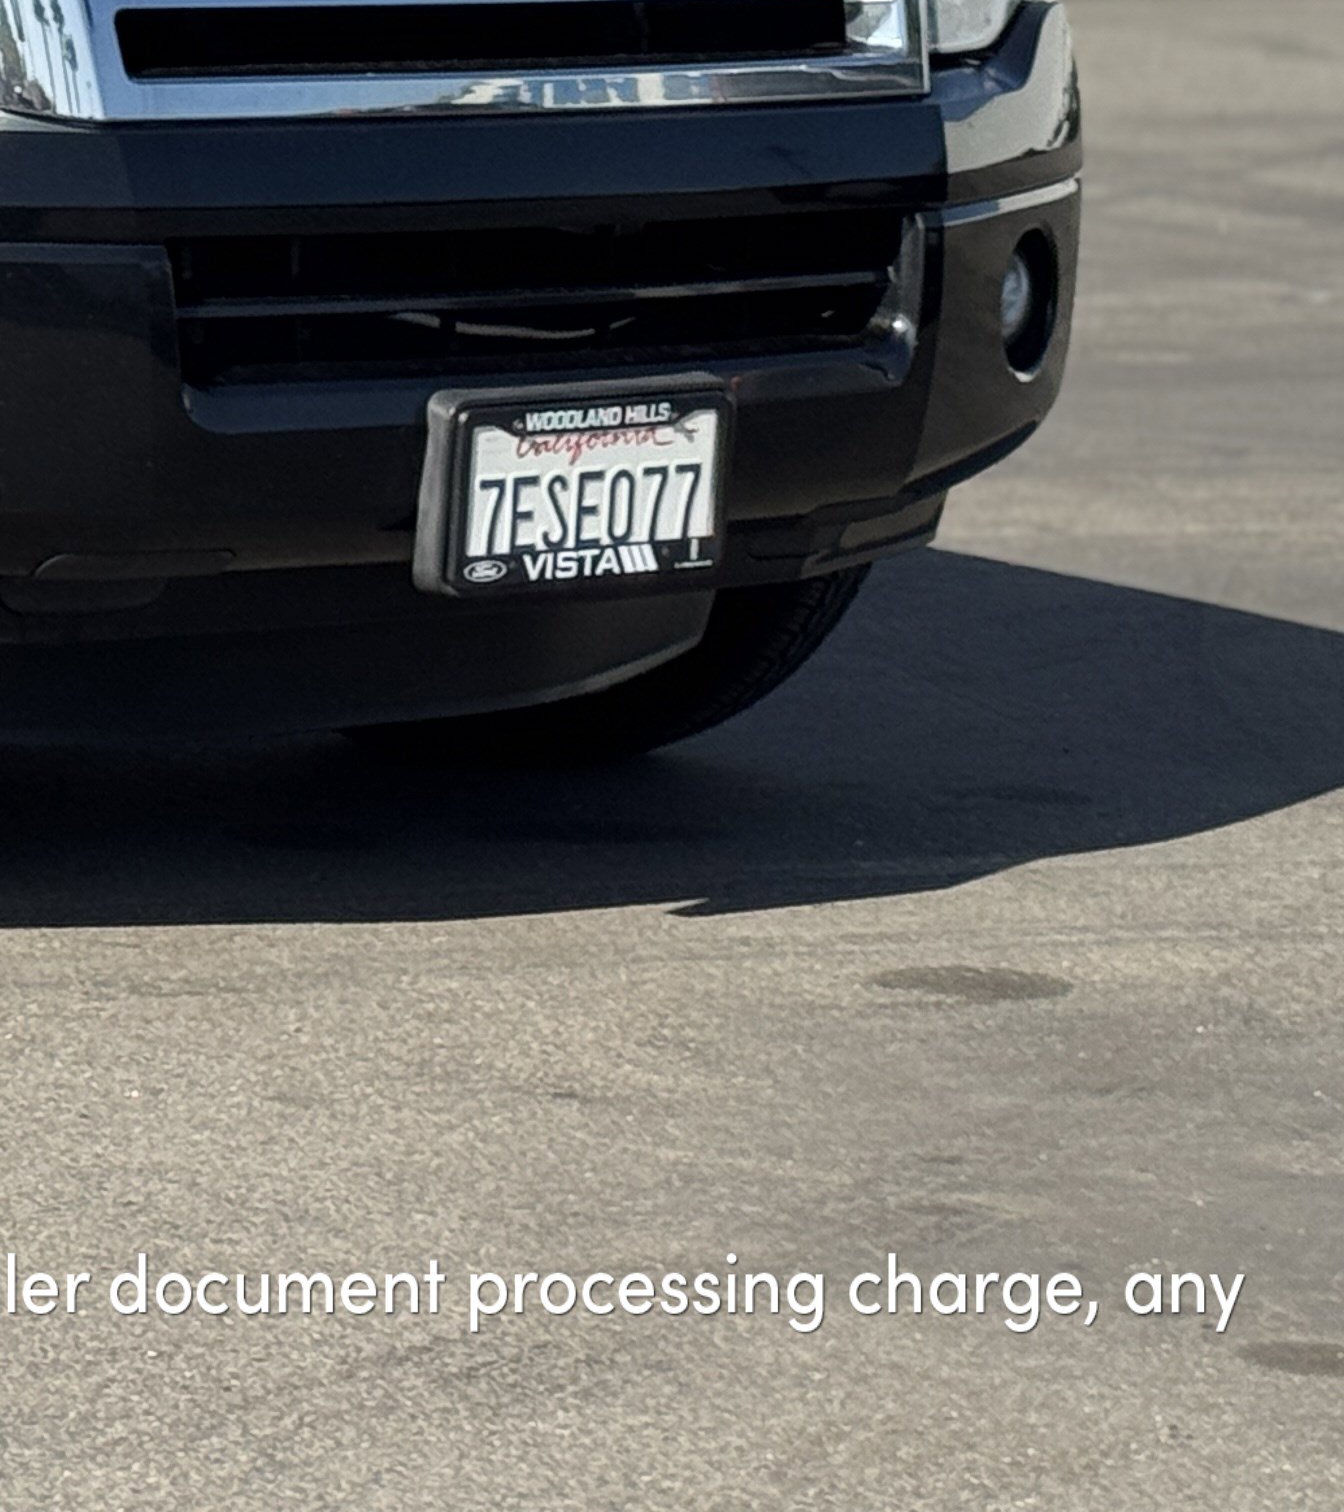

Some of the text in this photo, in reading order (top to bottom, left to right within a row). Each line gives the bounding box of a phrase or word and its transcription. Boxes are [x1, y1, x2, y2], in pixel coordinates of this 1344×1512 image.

[525, 401, 672, 432] WOODLAND HILLS
[477, 463, 703, 556] 7ESE077
[522, 547, 621, 582] VISTA
